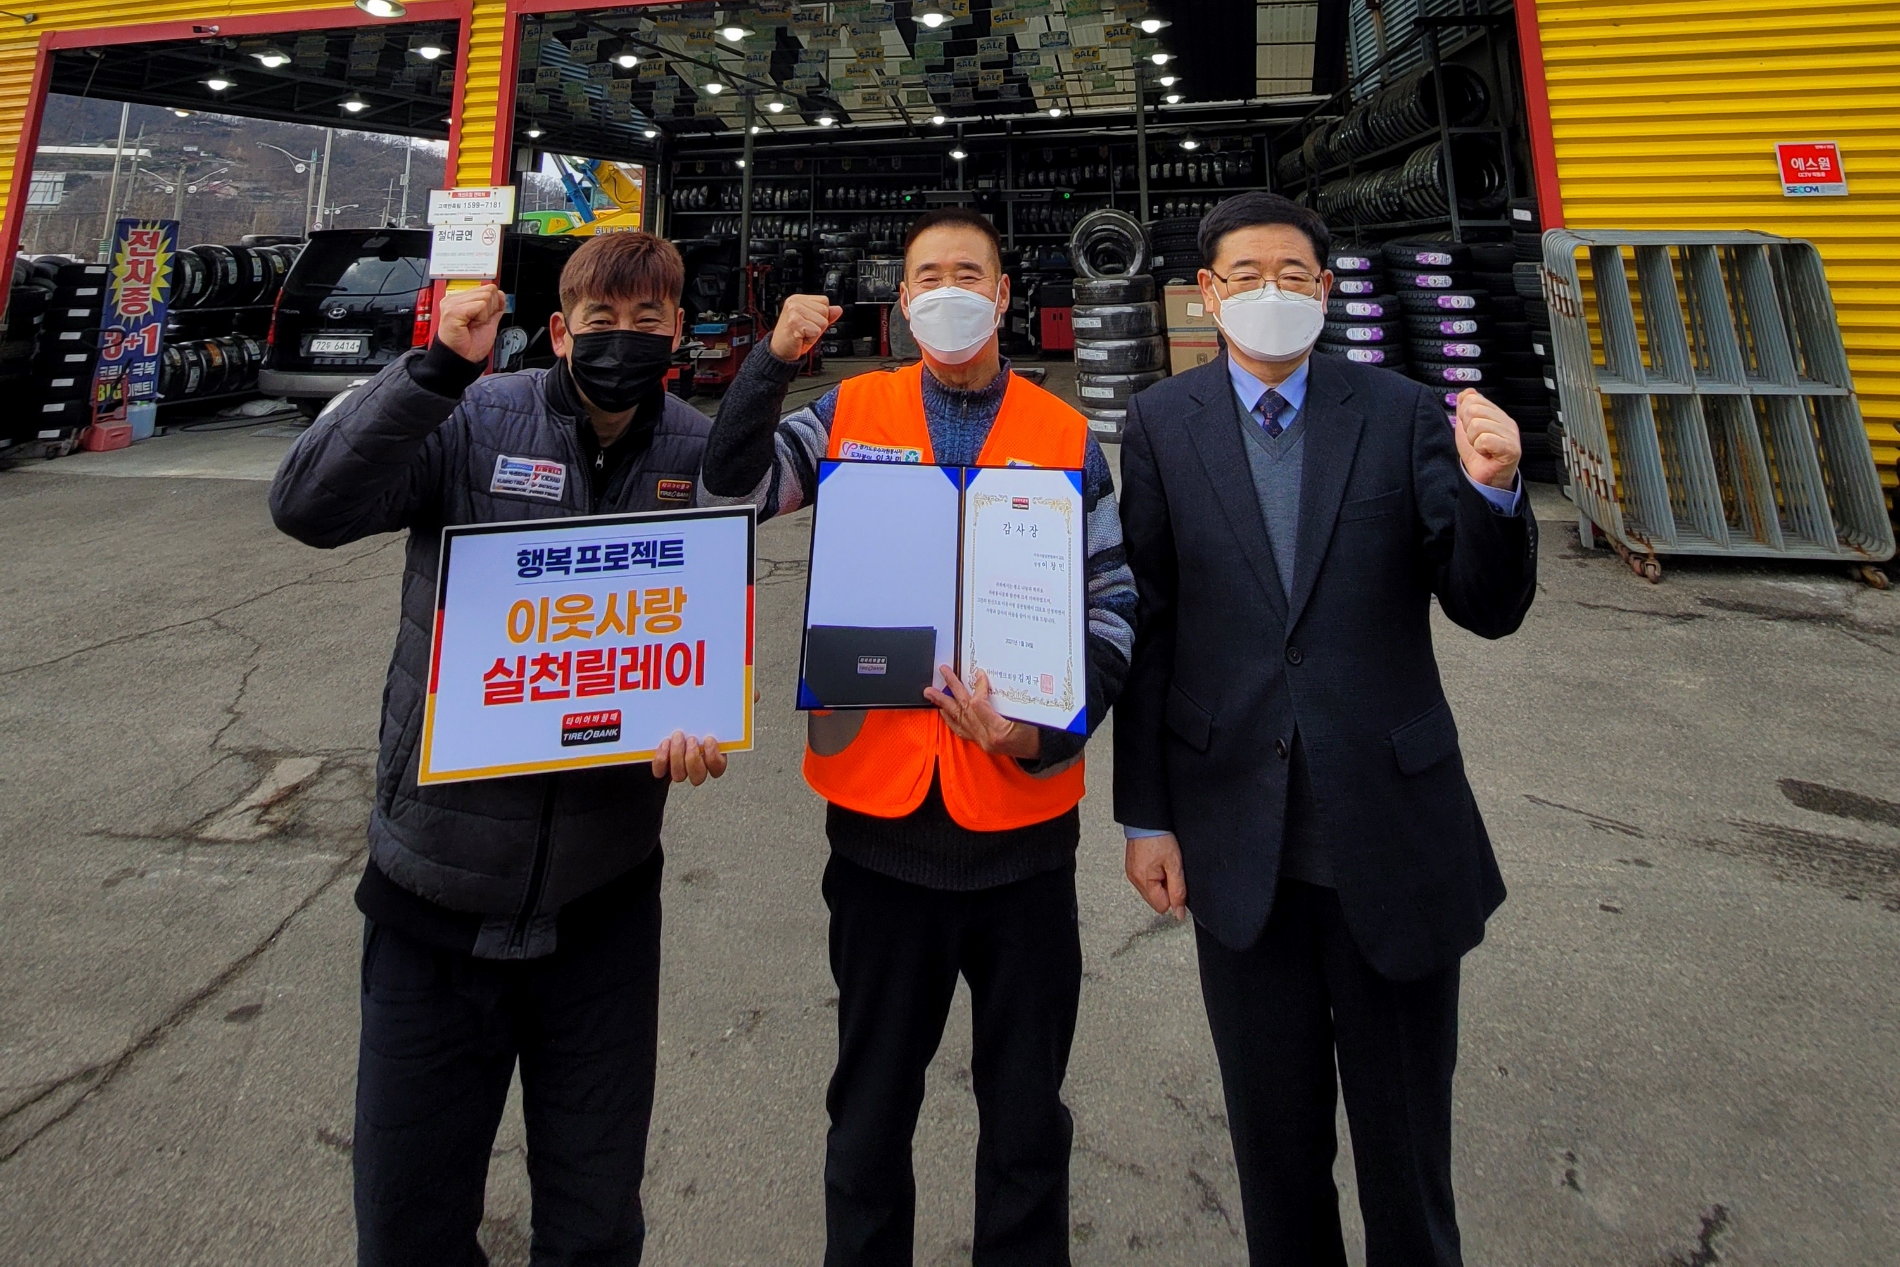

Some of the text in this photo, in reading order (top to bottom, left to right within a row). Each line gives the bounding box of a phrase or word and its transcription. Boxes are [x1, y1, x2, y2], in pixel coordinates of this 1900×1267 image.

[793, 13, 821, 23] SALE
[994, 12, 1015, 23] SAL
[689, 31, 713, 40] SALE
[1105, 28, 1132, 38] SALE
[573, 42, 596, 53] SALE
[980, 41, 1004, 51] SALE
[747, 55, 769, 63] SALE
[859, 51, 881, 59] SALE
[1074, 50, 1098, 59] SALE
[642, 63, 663, 72] SALE
[957, 59, 978, 68] SALE
[1084, 65, 1106, 73] SALE
[539, 70, 559, 79] SALE
[981, 75, 1001, 83] SALE
[1790, 156, 1832, 171] 에스원
[1786, 185, 1819, 194] SECOM
[463, 201, 502, 209] 1599-7181
[438, 229, 473, 242] 절대금연
[121, 230, 161, 315] 전차종
[103, 323, 161, 360] 3+1
[334, 341, 356, 351] 6414
[132, 361, 156, 376] 극복
[506, 586, 688, 644] 이웃사랑
[482, 639, 706, 706] 실천릴레이
